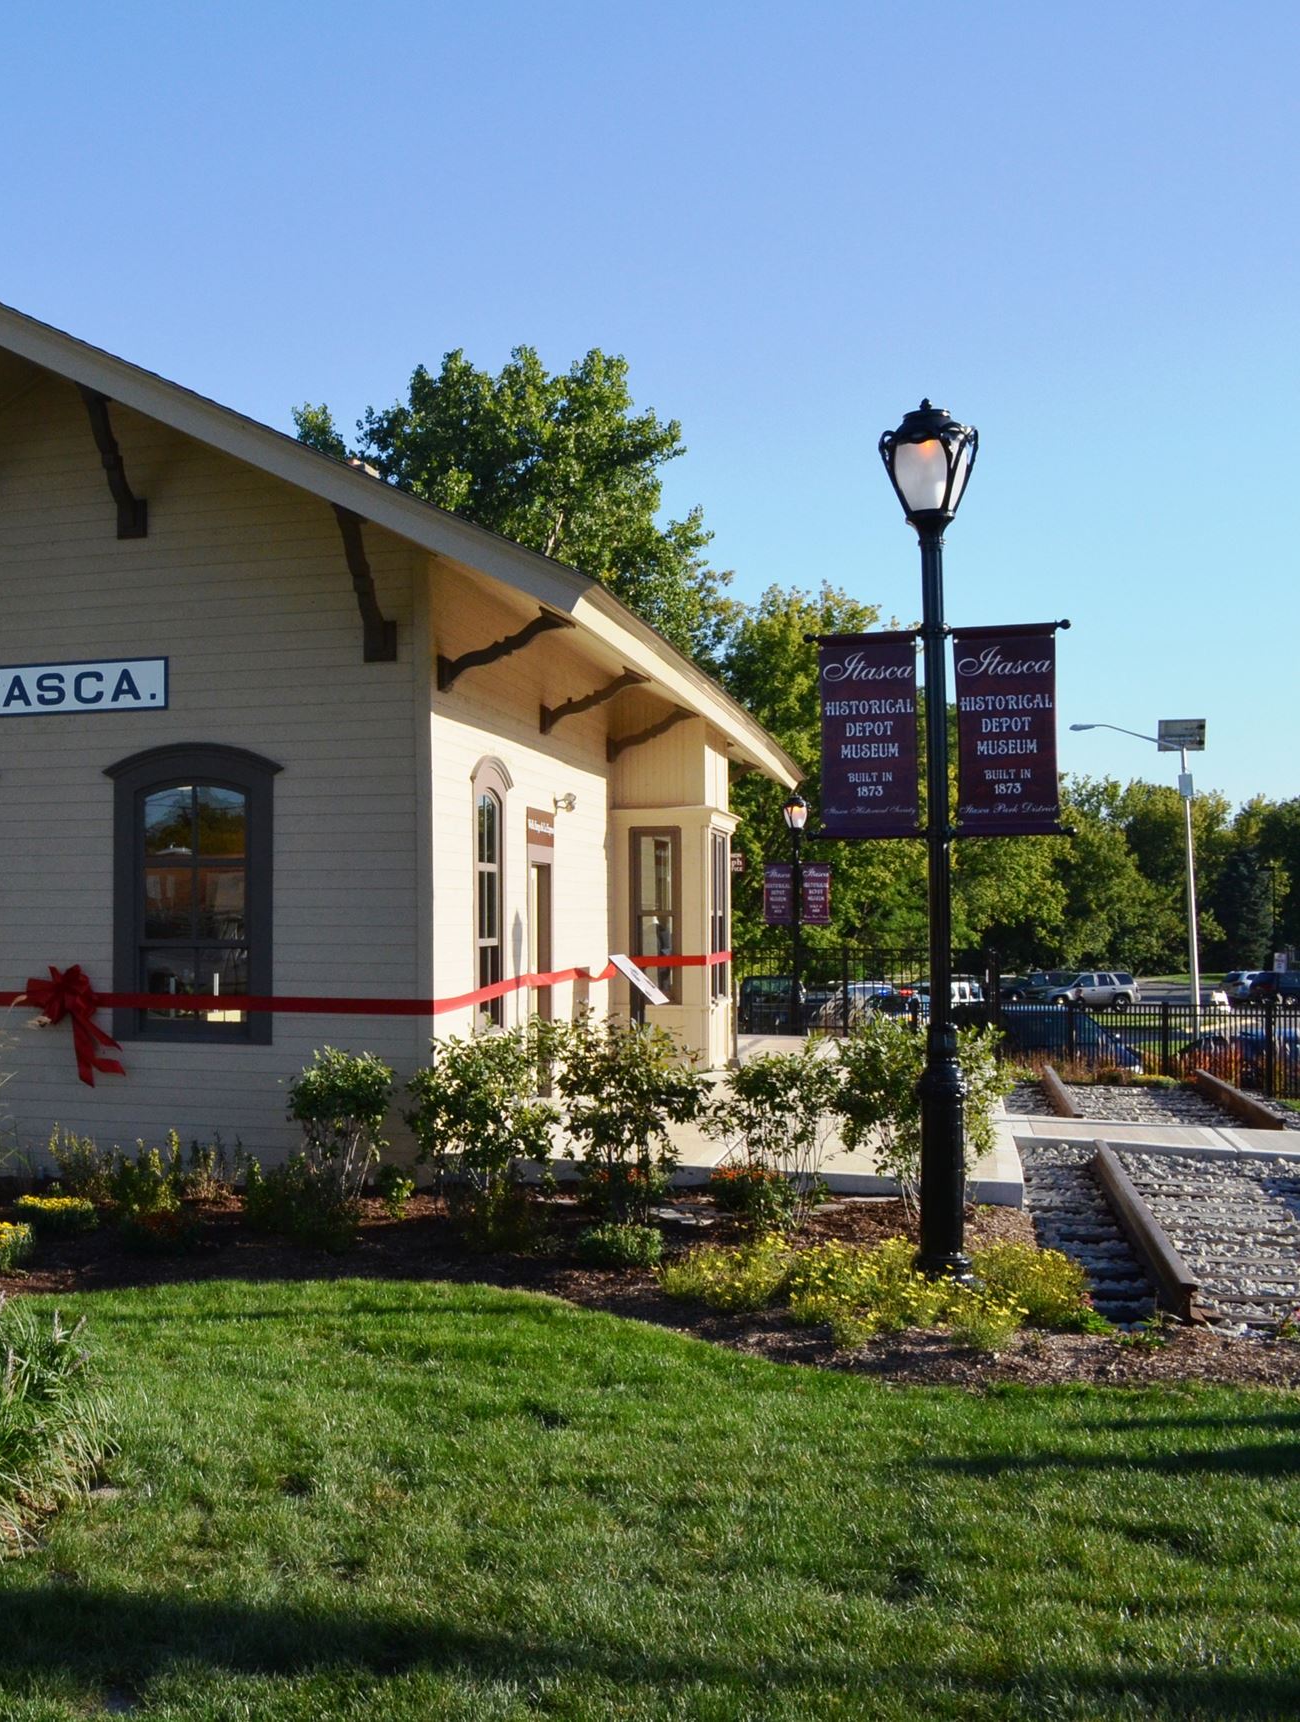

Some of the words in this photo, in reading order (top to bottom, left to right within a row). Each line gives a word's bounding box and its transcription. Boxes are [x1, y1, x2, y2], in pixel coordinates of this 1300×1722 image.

[823, 651, 914, 682] Itasca
[957, 645, 1052, 677] Itasca
[824, 698, 914, 716] HISTORICAL
[960, 693, 1053, 711] HISTORICAL
[845, 721, 894, 737] DEPOT
[981, 716, 1032, 733] DEPOT
[840, 743, 899, 759] MUSEUM
[976, 738, 1037, 756] MUSEUM
[847, 772, 878, 783] BUILT
[882, 771, 893, 782] IN
[984, 769, 1016, 780] BUILT
[1020, 768, 1032, 779] IN
[856, 785, 884, 797] 1873
[994, 783, 1022, 795] 1873
[992, 802, 1019, 814] Park
[1021, 802, 1058, 814] District
